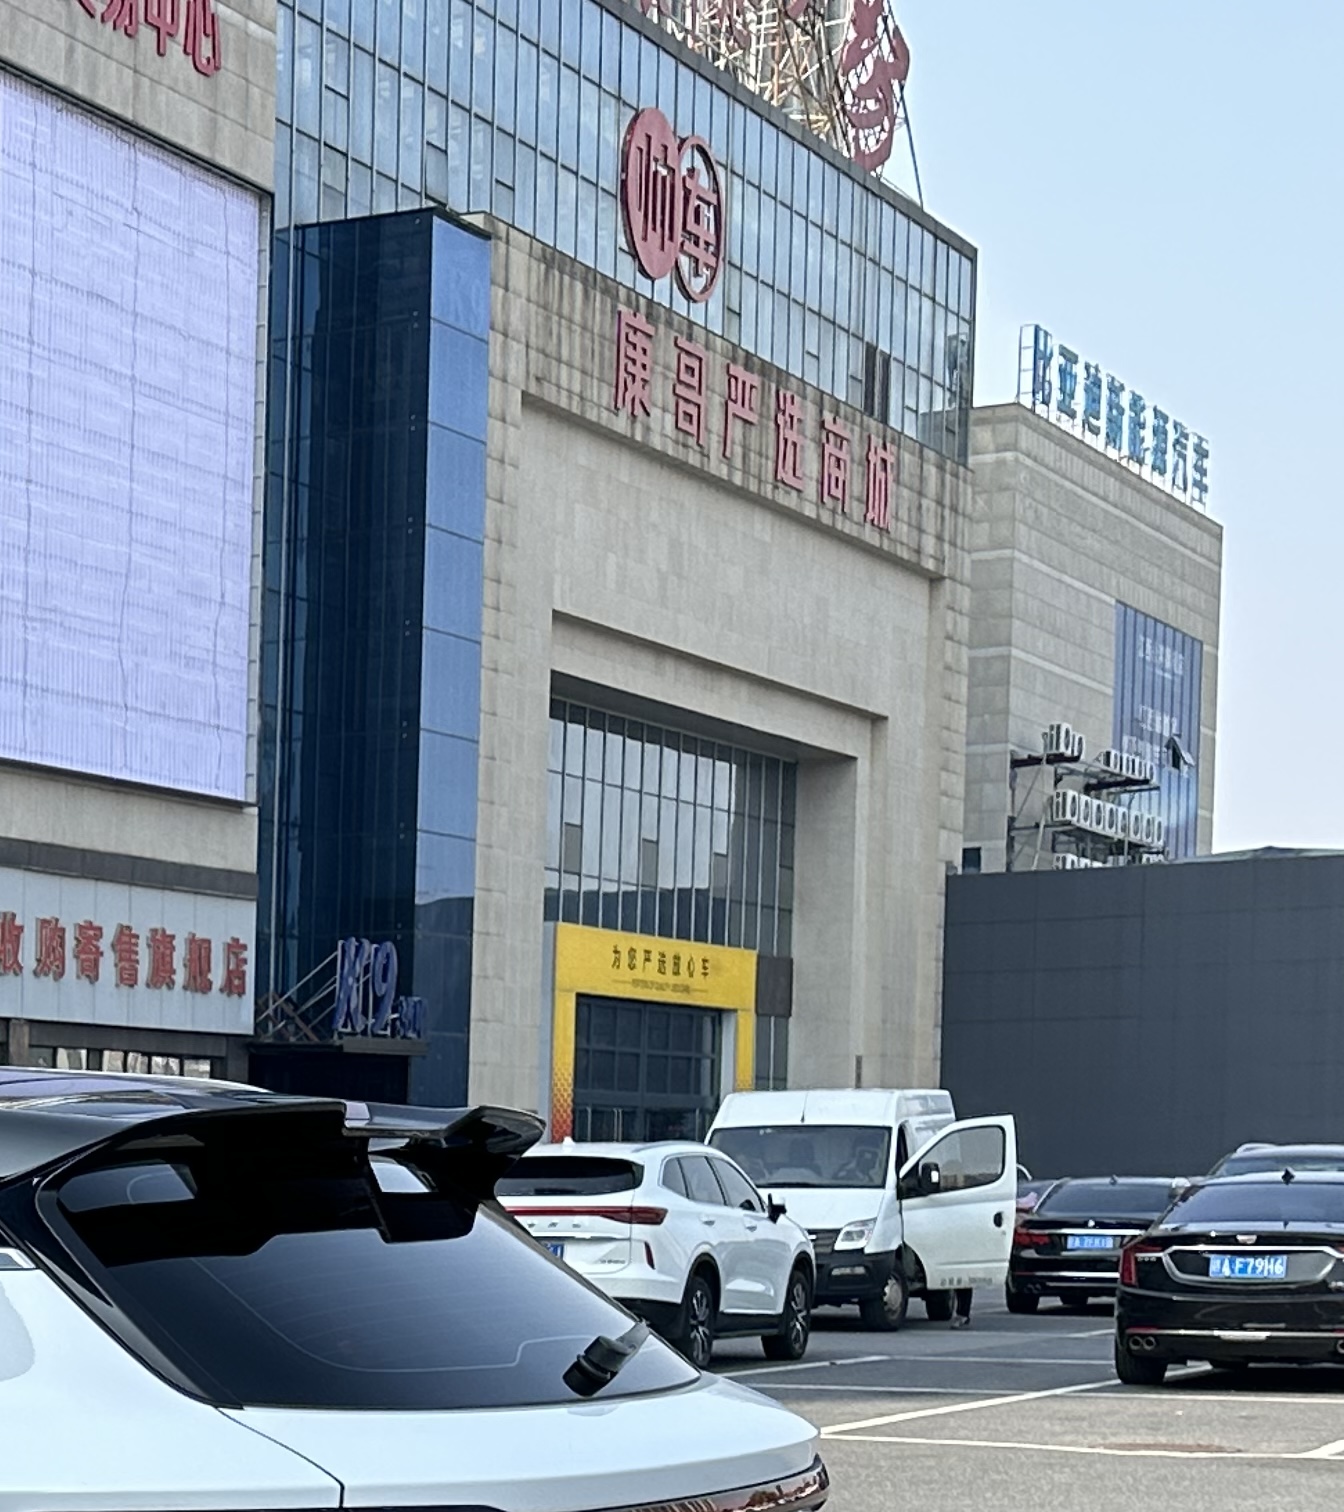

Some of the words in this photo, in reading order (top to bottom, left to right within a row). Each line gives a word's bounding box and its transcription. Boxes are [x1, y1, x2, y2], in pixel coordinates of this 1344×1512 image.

[614, 308, 896, 533] 康哥严选商城
[1033, 323, 1210, 505] 比亚迪新能源汽车
